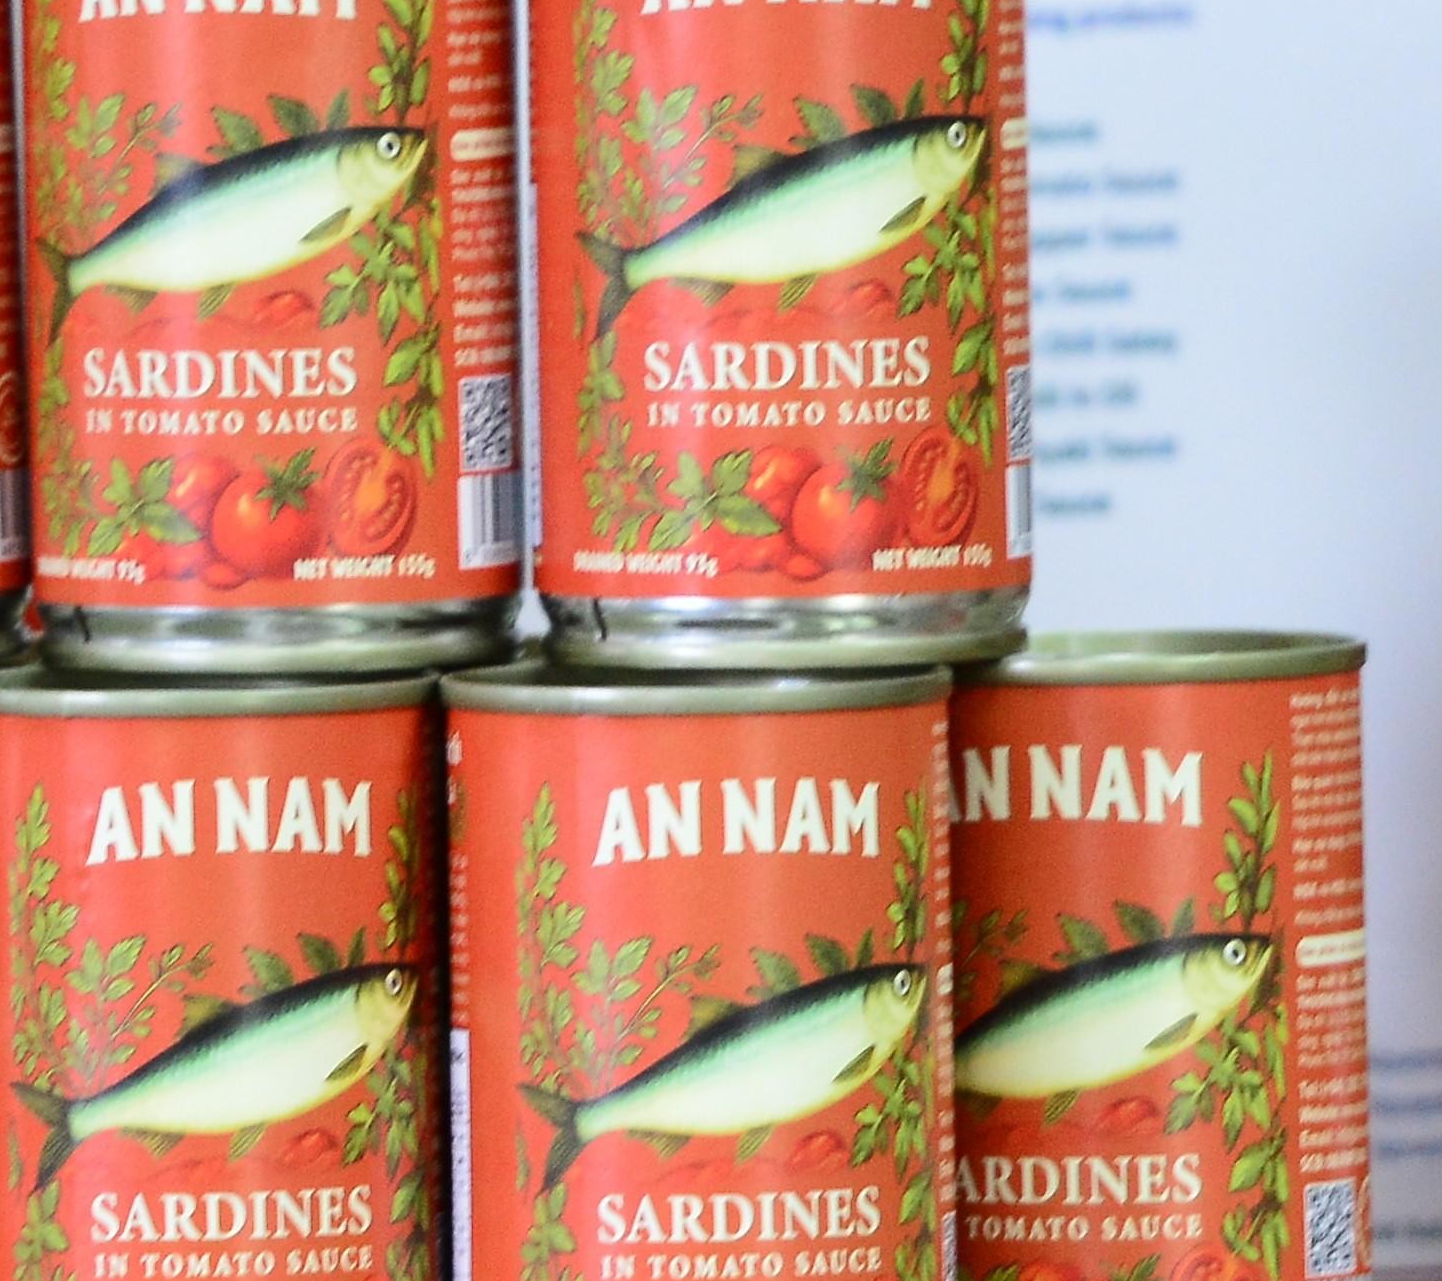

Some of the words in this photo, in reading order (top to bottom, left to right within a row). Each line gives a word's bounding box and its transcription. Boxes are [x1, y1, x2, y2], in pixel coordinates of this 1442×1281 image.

[82, 344, 359, 402] SARDINES
[643, 336, 932, 395] SARDINES
[84, 408, 113, 435] IN
[120, 407, 246, 436] TOMATO
[256, 406, 359, 435] SAUCE
[647, 401, 681, 428] IN
[691, 400, 826, 428] TOMATO
[836, 397, 932, 424] SAUCE
[1028, 744, 1203, 827] NAM
[86, 780, 195, 865] AN
[215, 776, 373, 857] NAM
[591, 782, 702, 866] AN
[720, 777, 881, 859] NAM
[954, 1153, 1203, 1206] ARDINES
[89, 1184, 373, 1244] SARDINES
[596, 1184, 882, 1245] SARDINES
[965, 1215, 1094, 1242] TOMATO
[1102, 1212, 1203, 1240] SAUCE
[93, 1253, 126, 1279] IN
[140, 1251, 275, 1279] TOMATO
[286, 1245, 373, 1274] SAUCE
[600, 1252, 636, 1280] IN
[647, 1251, 783, 1279] TOMATO
[794, 1247, 883, 1275] SAUCE
